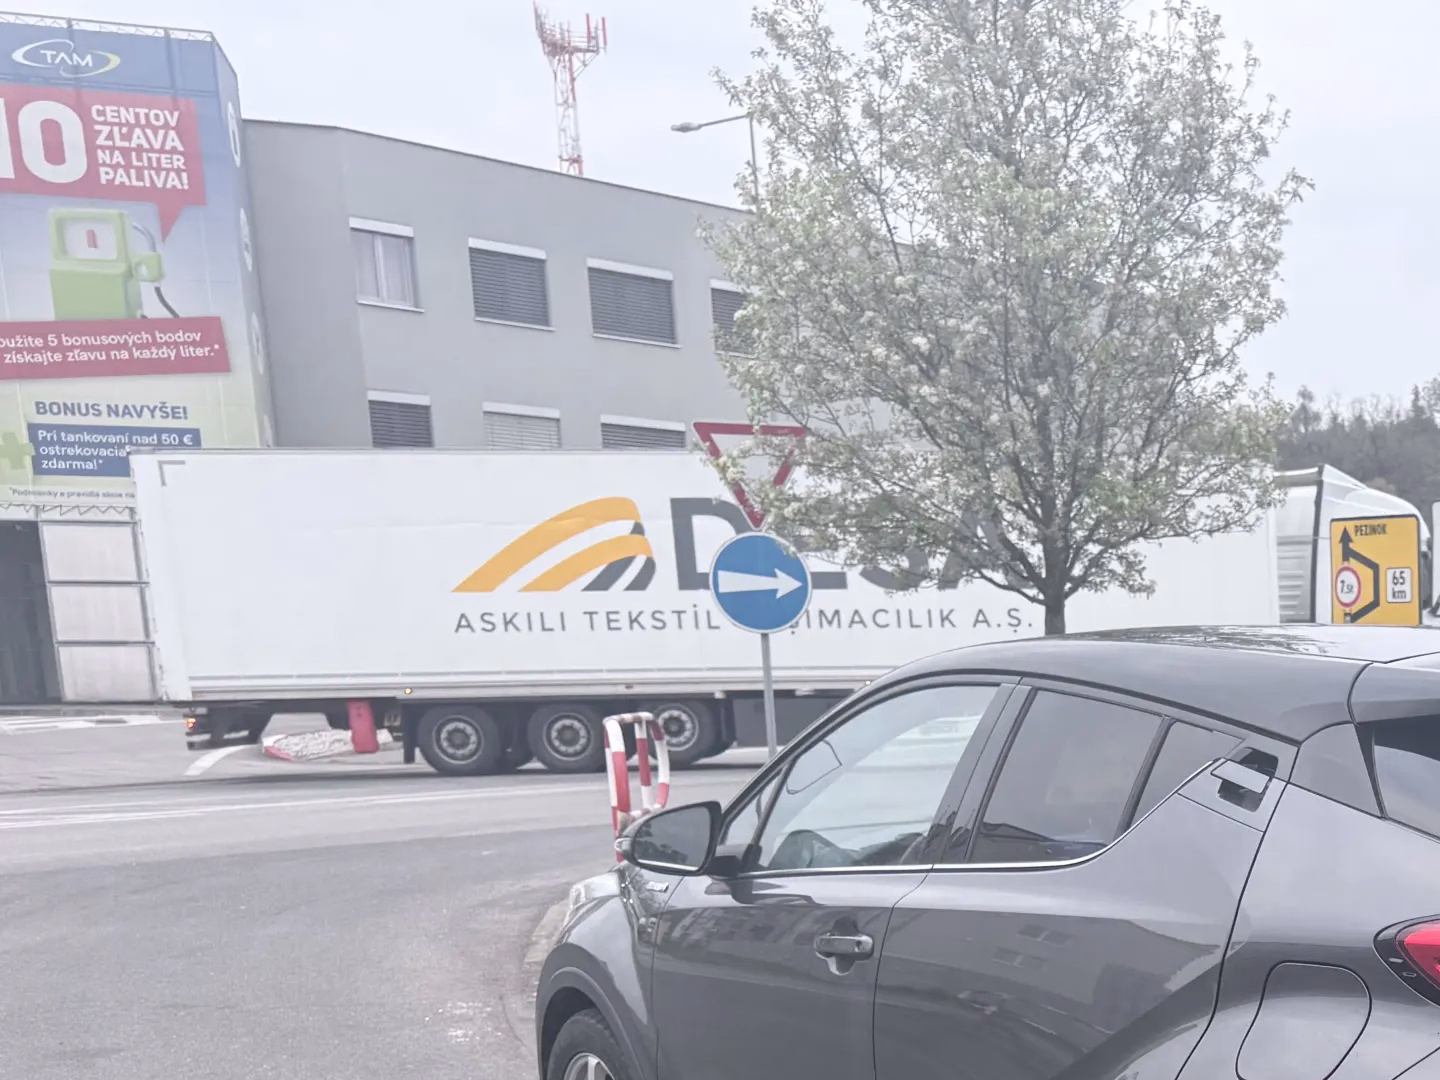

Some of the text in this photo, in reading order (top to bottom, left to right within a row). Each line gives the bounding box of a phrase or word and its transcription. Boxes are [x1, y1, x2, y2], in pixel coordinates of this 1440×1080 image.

[40, 49, 93, 67] TAM
[91, 104, 180, 128] CENTOV
[93, 124, 185, 151] ZĽAVA
[96, 149, 187, 170] NA LITER
[99, 166, 190, 190] PALIVA!
[47, 333, 58, 347] 5
[61, 330, 152, 347] bonusových
[155, 329, 202, 343] bodov
[3, 350, 63, 366] získajte
[110, 348, 128, 361] na
[132, 344, 177, 360] každý
[35, 401, 189, 420] BONUS NAVYŠE!
[61, 431, 129, 444] tankovaní
[132, 433, 158, 445] nad
[161, 433, 179, 445] 50
[183, 434, 194, 446] €
[1354, 524, 1387, 536] PEZINOK
[1392, 570, 1406, 586] 65
[1391, 587, 1407, 600] km
[454, 611, 567, 634] ASKILI
[583, 603, 721, 632] TEKSTİL
